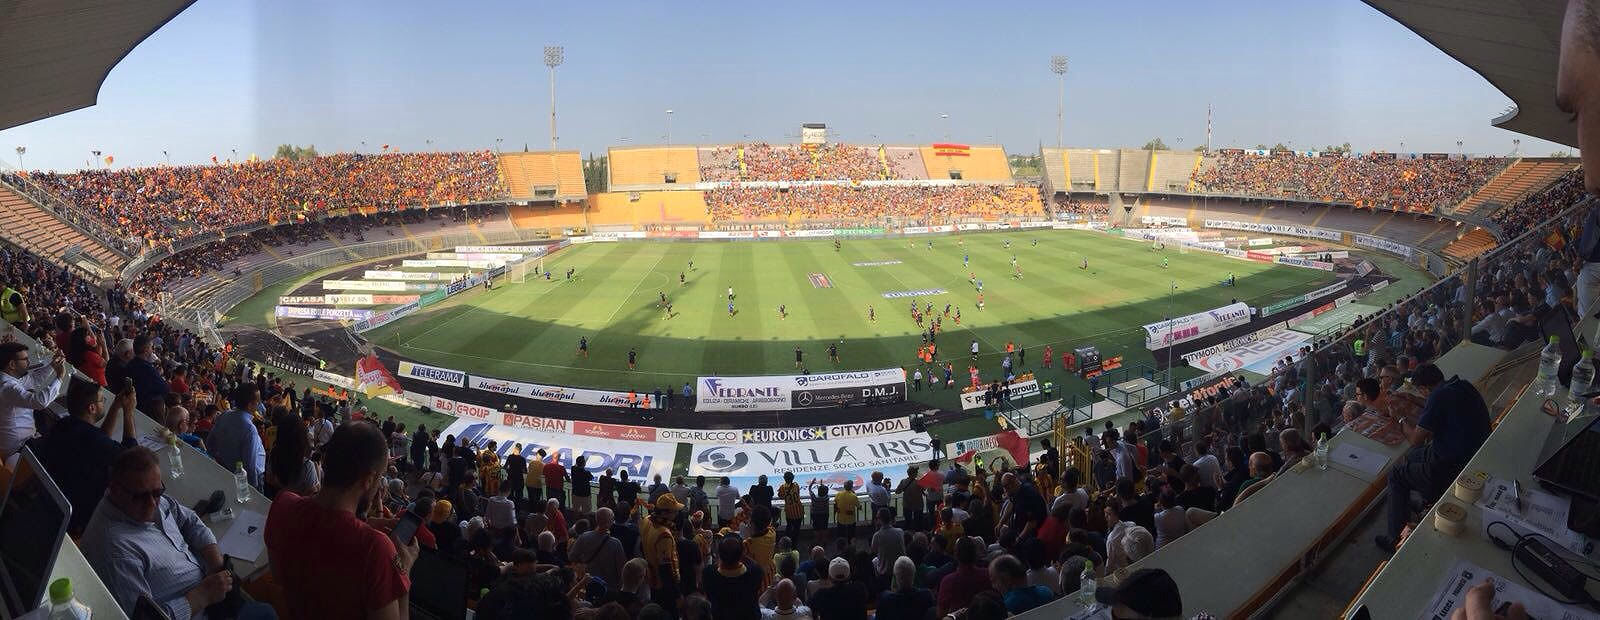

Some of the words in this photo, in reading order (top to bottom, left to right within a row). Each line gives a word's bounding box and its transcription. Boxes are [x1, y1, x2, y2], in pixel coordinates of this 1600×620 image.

[415, 366, 460, 384] TELERAMA
[479, 382, 519, 394] blumapul
[530, 388, 576, 401] blumapul
[862, 386, 899, 398] D.M.J.
[456, 404, 490, 419] GROUP
[513, 415, 567, 431] PASIAN
[831, 419, 905, 437] CITYMODA
[661, 430, 695, 440] OTTICA
[695, 432, 736, 441] RUCCO
[754, 428, 816, 442] EURONICS
[757, 446, 857, 467] VILLA
[867, 437, 931, 459] IRIS
[774, 464, 831, 474] RESIDENZE
[834, 462, 865, 470] SOCIO
[869, 454, 920, 467] SANITARIE
